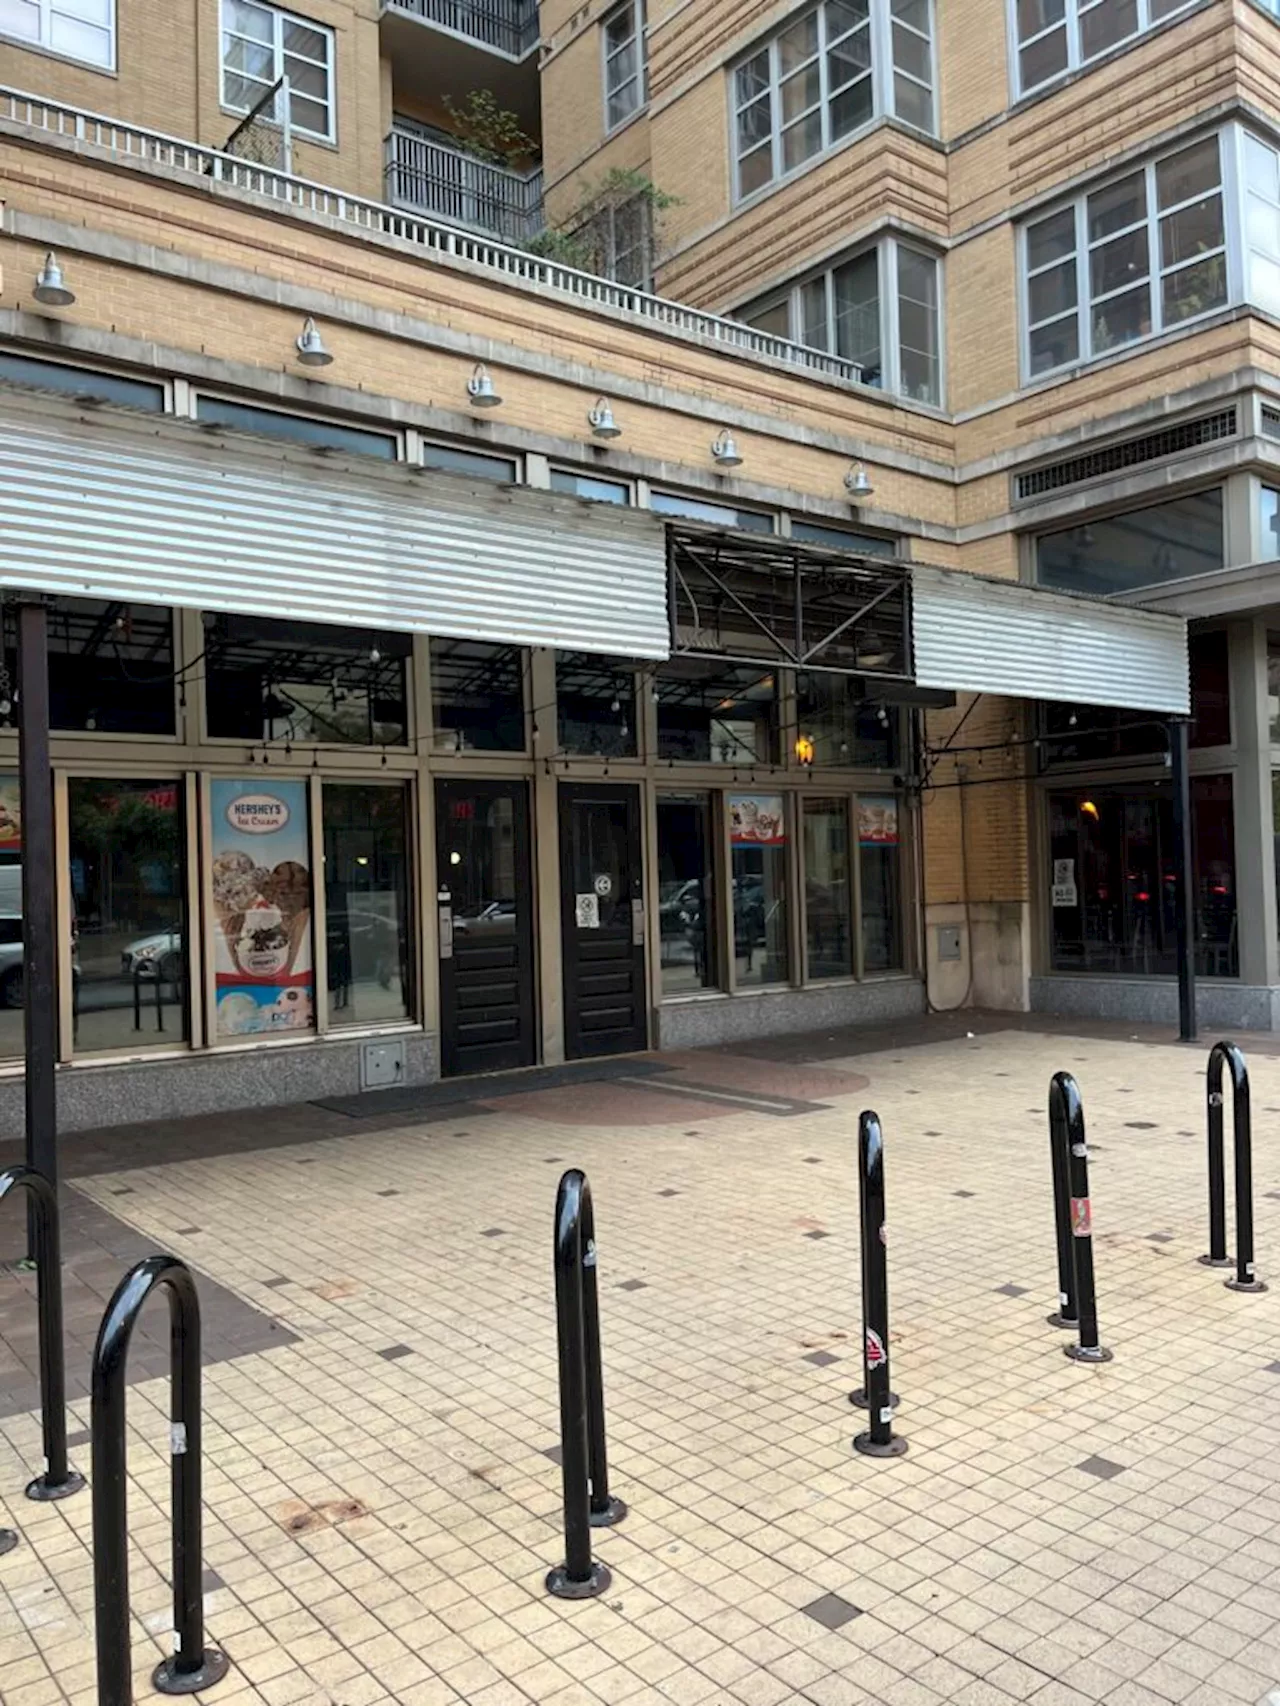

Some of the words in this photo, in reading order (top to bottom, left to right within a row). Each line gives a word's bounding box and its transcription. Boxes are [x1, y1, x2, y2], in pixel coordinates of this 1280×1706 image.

[234, 804, 281, 815] HERSHEY'S
[237, 815, 250, 825] Ice
[251, 816, 279, 825] Cream
